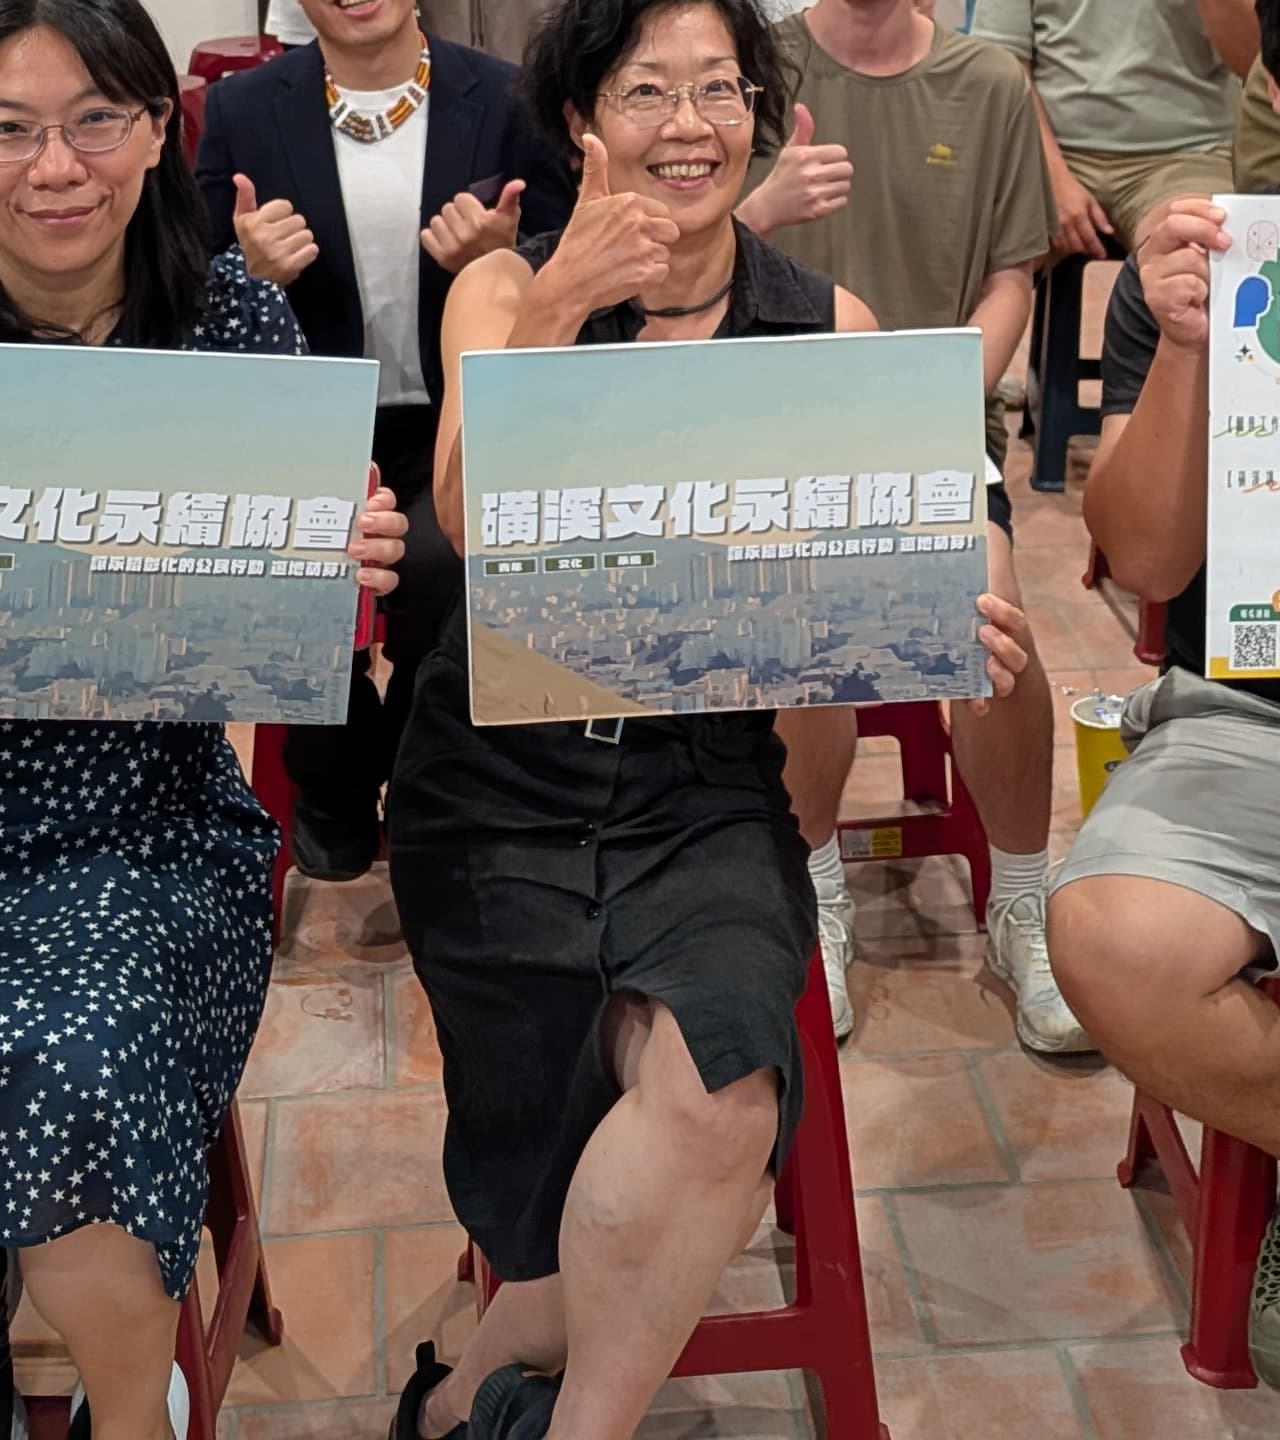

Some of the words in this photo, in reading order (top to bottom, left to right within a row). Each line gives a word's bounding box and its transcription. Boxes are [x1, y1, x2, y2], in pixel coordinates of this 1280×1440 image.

[481, 470, 977, 547] 磺溪文化永續協會
[558, 558, 583, 570] 文化
